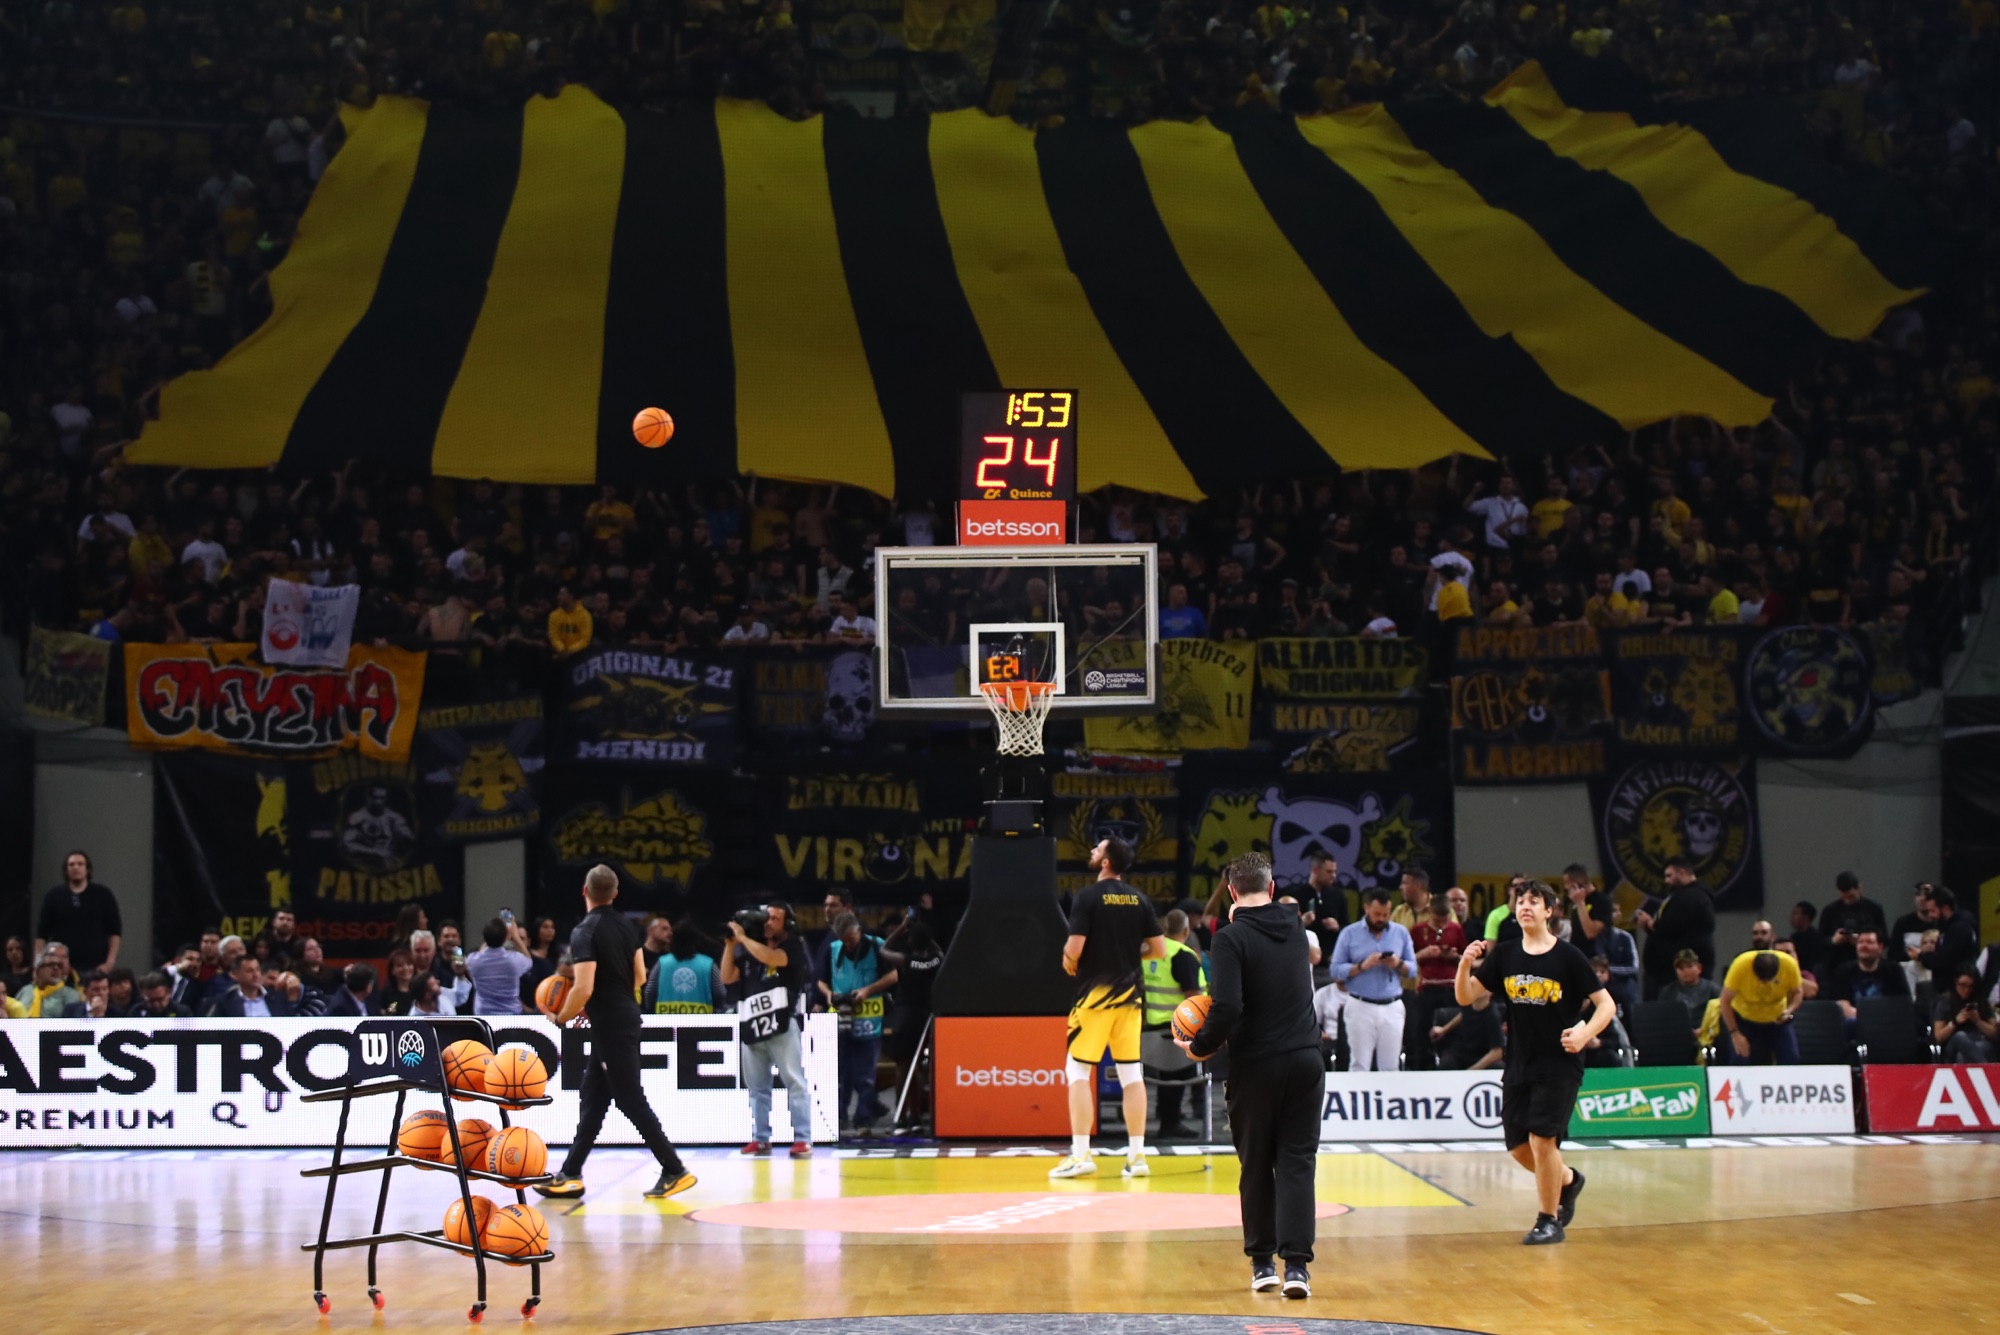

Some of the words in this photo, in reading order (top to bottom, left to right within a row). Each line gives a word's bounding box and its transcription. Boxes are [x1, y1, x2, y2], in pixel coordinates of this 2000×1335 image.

[1006, 392, 1072, 428] 1:53
[976, 435, 1059, 488] 24
[1009, 488, 1053, 499] Quince
[966, 518, 1059, 536] betsson
[571, 650, 698, 686] ORIGINAL
[704, 664, 734, 689] 21
[1167, 640, 1247, 678] rythrea
[1274, 705, 1370, 732] KIATO
[575, 739, 706, 761] MENIDI
[315, 862, 444, 904] PATISSIA
[1102, 893, 1139, 906] SKORDILIS
[909, 957, 942, 971] macron
[750, 994, 773, 1012] HB
[955, 1065, 1067, 1087] betsson
[1761, 1083, 1846, 1104] PAPPAS
[1322, 1089, 1453, 1121] Allianz
